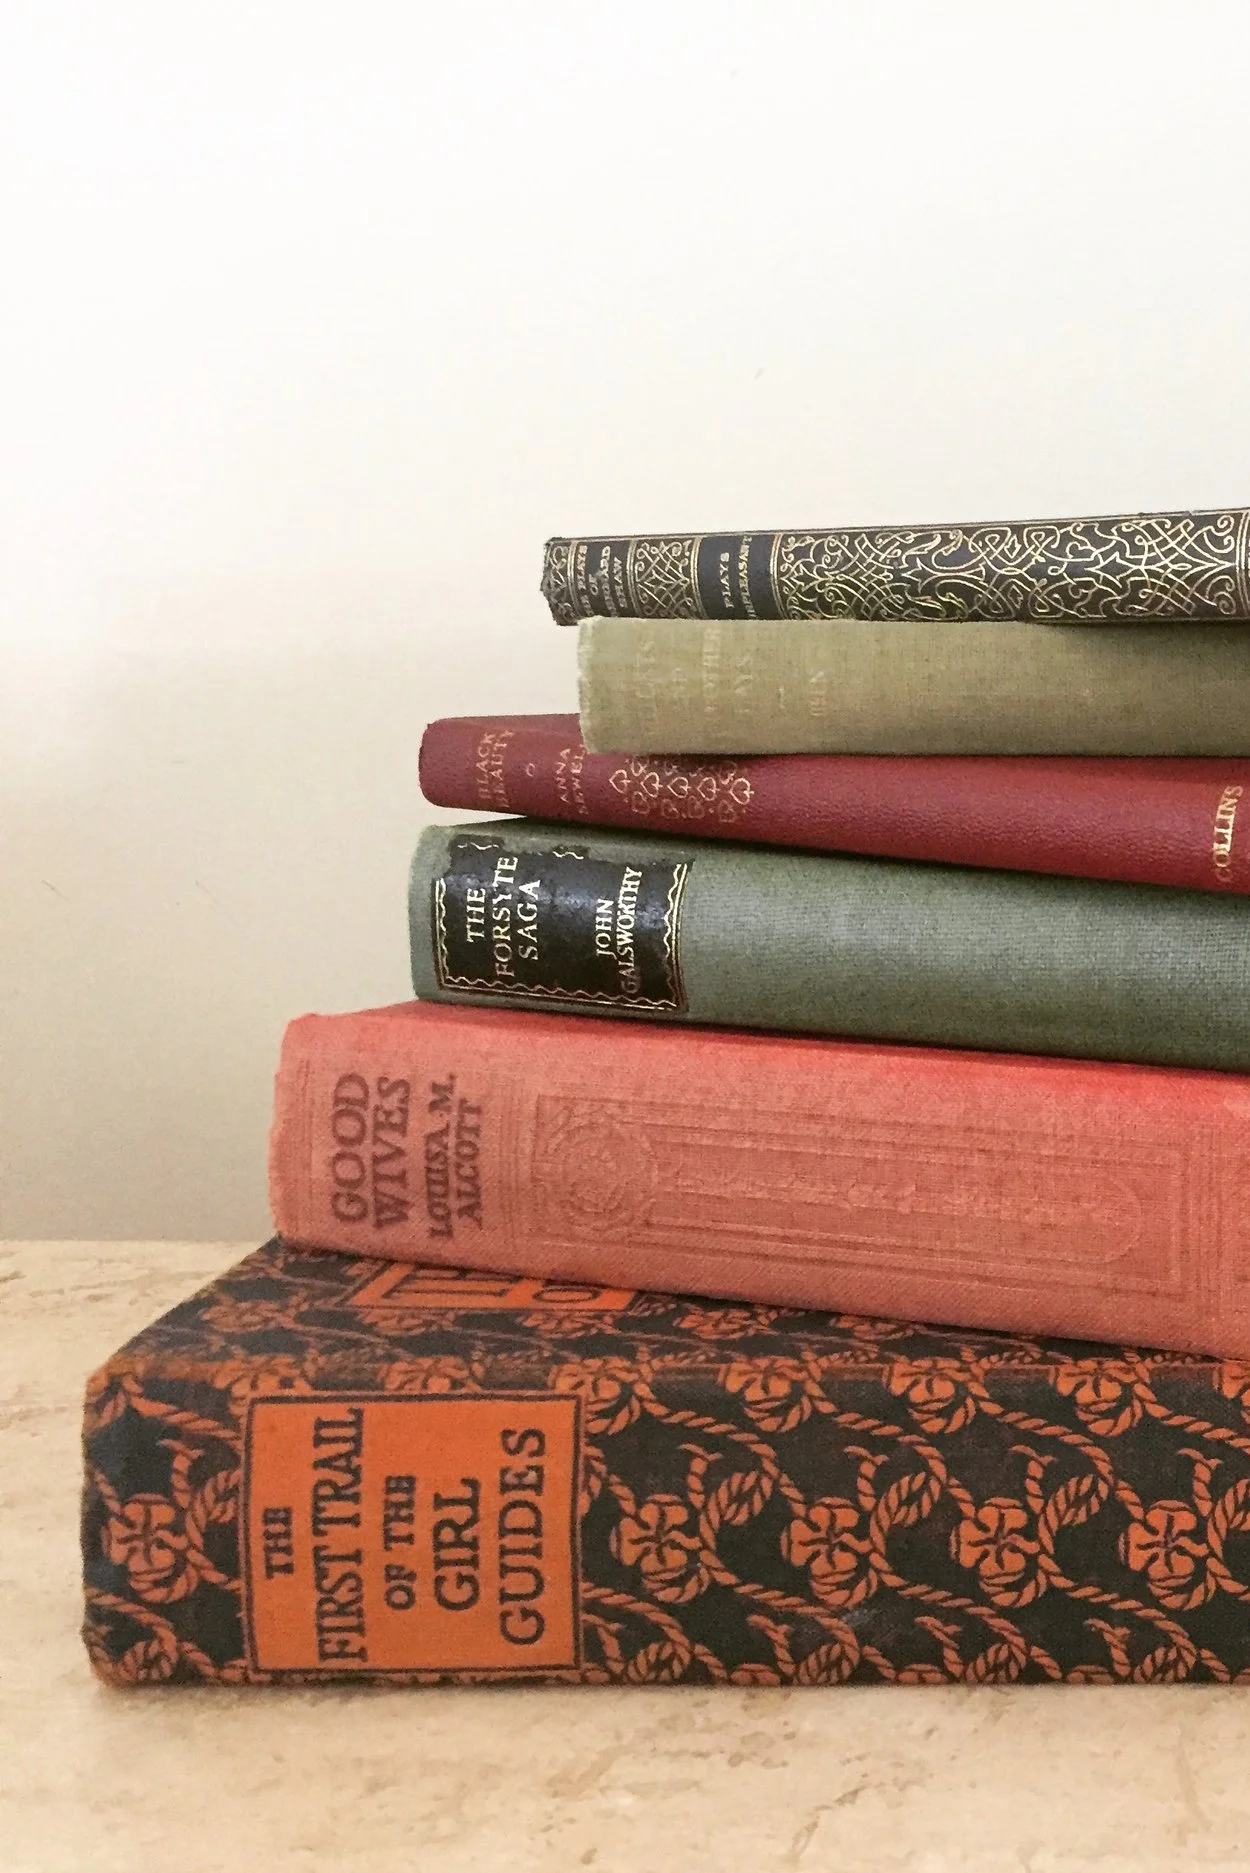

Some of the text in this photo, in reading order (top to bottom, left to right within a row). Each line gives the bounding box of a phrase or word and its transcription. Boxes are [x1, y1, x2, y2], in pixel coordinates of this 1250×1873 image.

[719, 552, 735, 608] PLAYS
[476, 732, 496, 801] BLACK
[491, 729, 513, 810] BEAUTY
[554, 748, 571, 804] ANNA
[1213, 785, 1243, 882] COLLINS
[466, 887, 487, 942] THE
[492, 856, 518, 977] FORSYTE
[517, 879, 541, 961] SAGA
[595, 898, 617, 959] JOHN
[616, 866, 643, 994] GALSWORTHY
[331, 1073, 370, 1225] GOOD
[373, 1076, 411, 1230] WIVES
[425, 1073, 458, 1239] LOUISA M.
[455, 1098, 484, 1231] ALCOTT
[262, 1506, 295, 1579] THE
[311, 1408, 369, 1663] FIRST TRAIL
[383, 1475, 417, 1611] OF THE
[432, 1477, 481, 1612] GIRL
[499, 1428, 546, 1646] GUIDES
